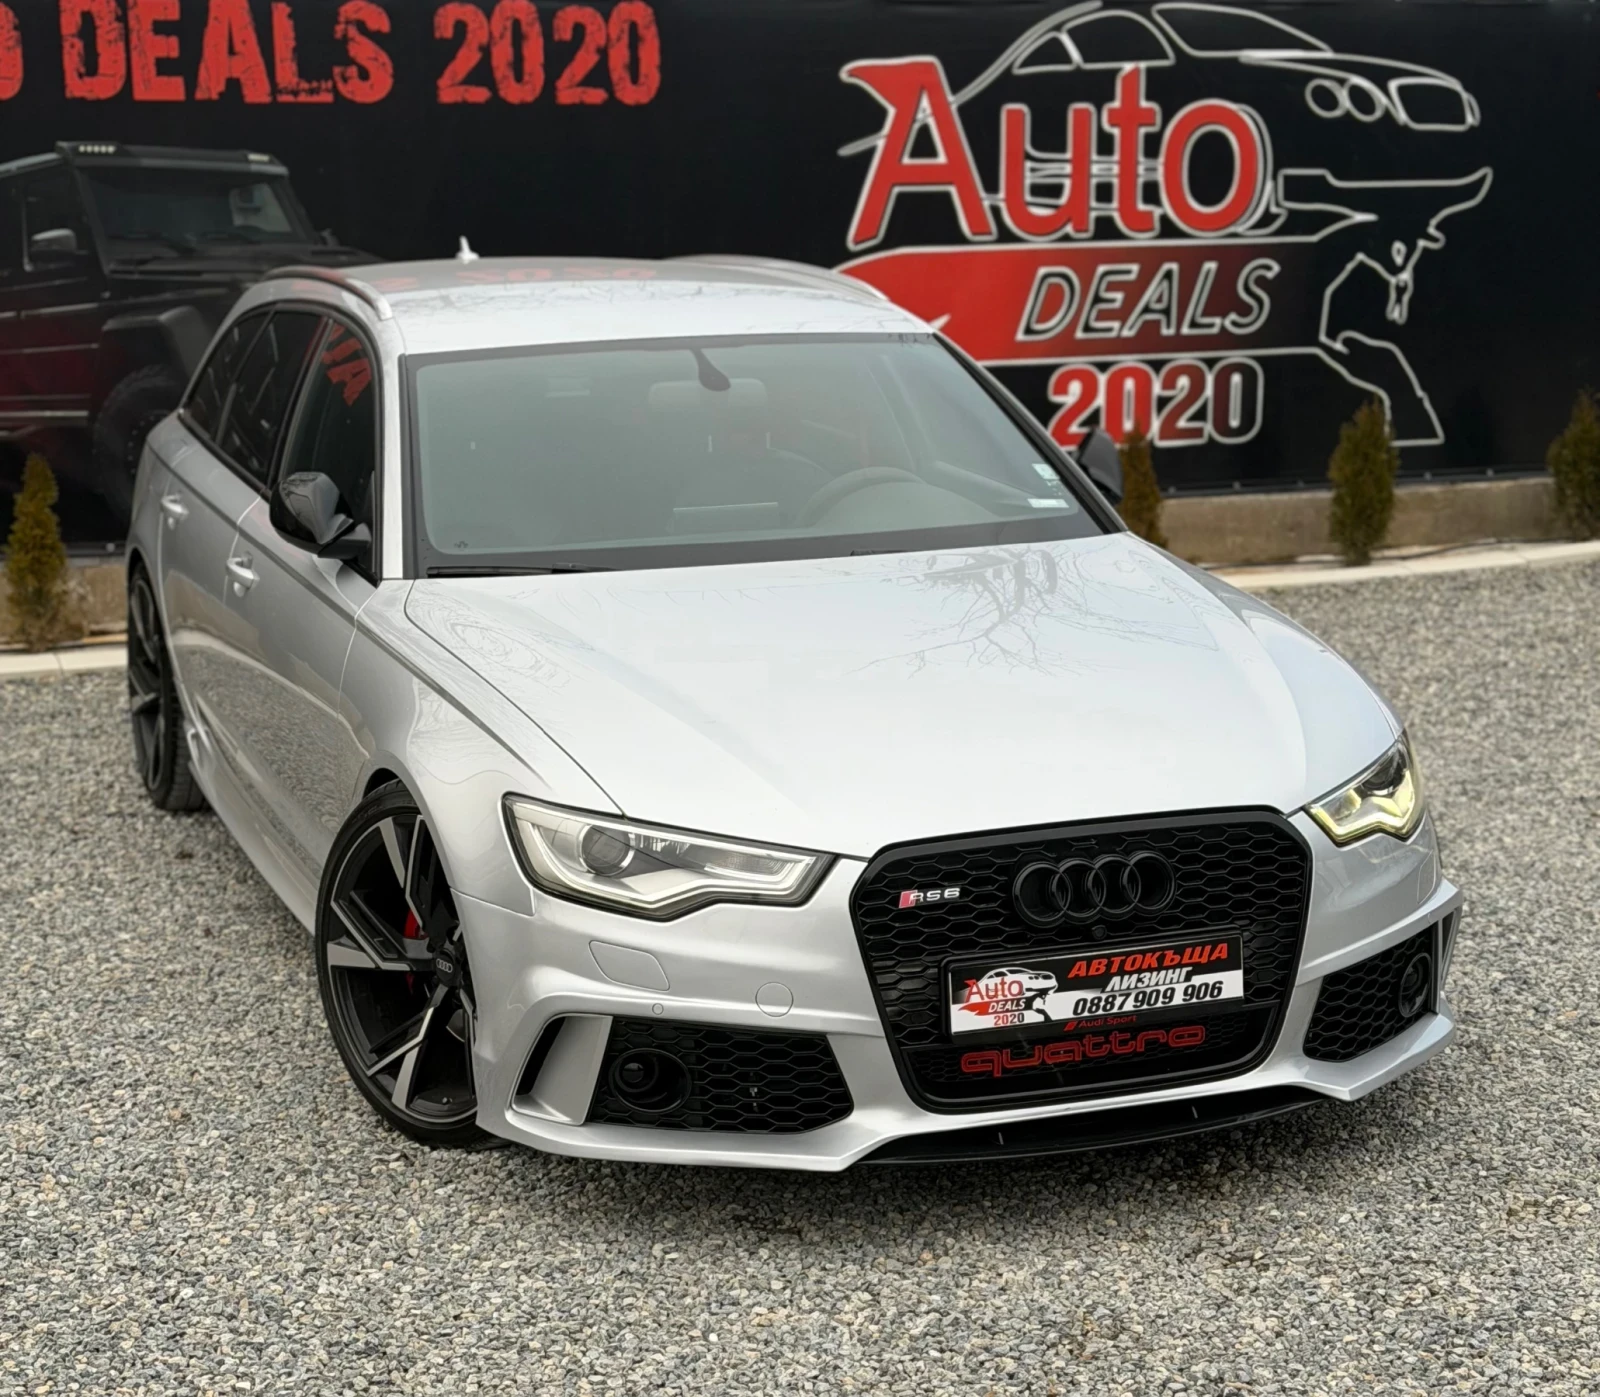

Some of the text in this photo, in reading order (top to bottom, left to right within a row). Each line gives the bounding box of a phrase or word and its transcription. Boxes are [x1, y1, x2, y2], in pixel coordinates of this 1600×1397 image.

[59, 0, 394, 104] DEALS
[433, 0, 662, 106] 2020
[840, 56, 1265, 250] Auto
[1015, 259, 1280, 343] DEALS
[1047, 357, 1264, 450] 2020
[907, 887, 961, 905] RS6
[1067, 942, 1229, 979] АВТОКЪЩА
[964, 976, 1025, 1003] Auto
[1104, 966, 1193, 993] ЛИЗИНГ
[988, 999, 1025, 1013] DEALS
[1072, 980, 1224, 1017] 0887 909 906
[993, 1012, 1025, 1026] 2020
[1078, 1014, 1137, 1028] Audi Sport
[960, 1025, 1205, 1077] quattro
